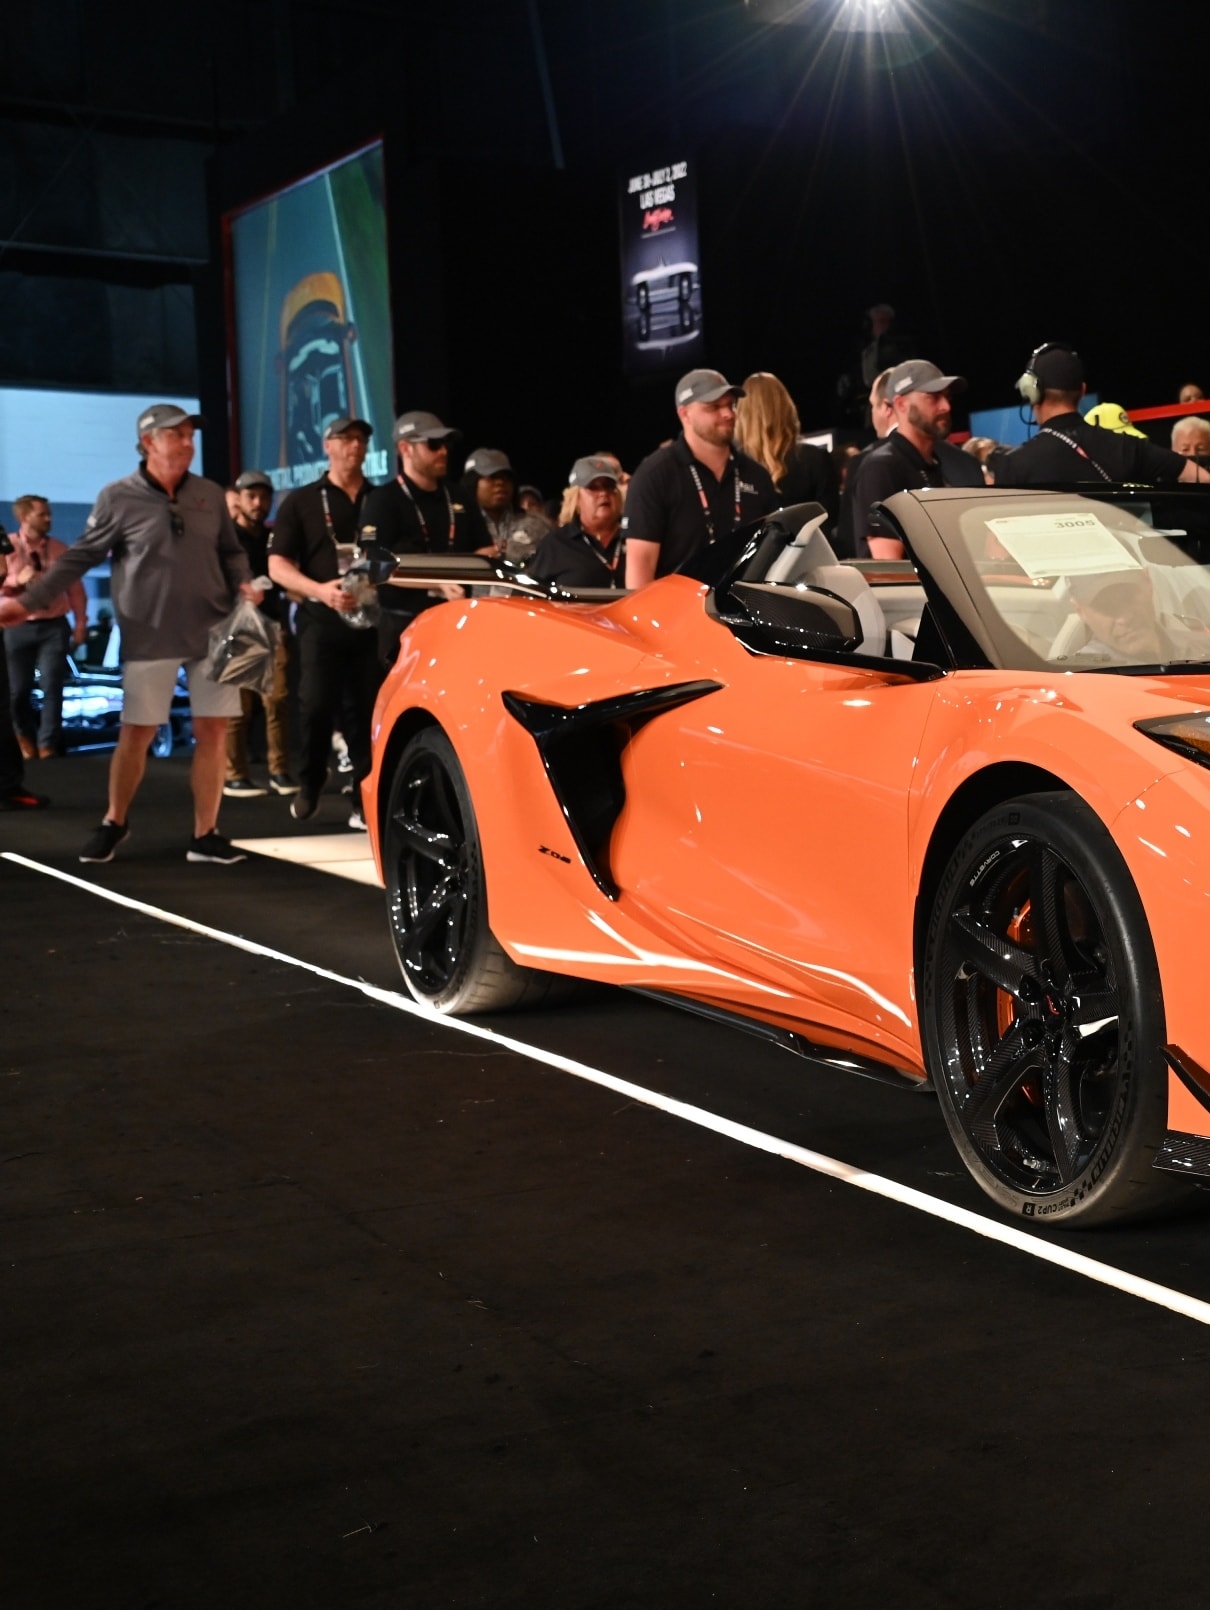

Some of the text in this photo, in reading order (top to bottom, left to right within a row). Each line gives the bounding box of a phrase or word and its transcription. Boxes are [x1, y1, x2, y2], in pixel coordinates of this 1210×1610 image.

[1054, 519, 1095, 528] 3005
[538, 845, 571, 864] Z06
[970, 850, 1000, 887] CORVETTE
